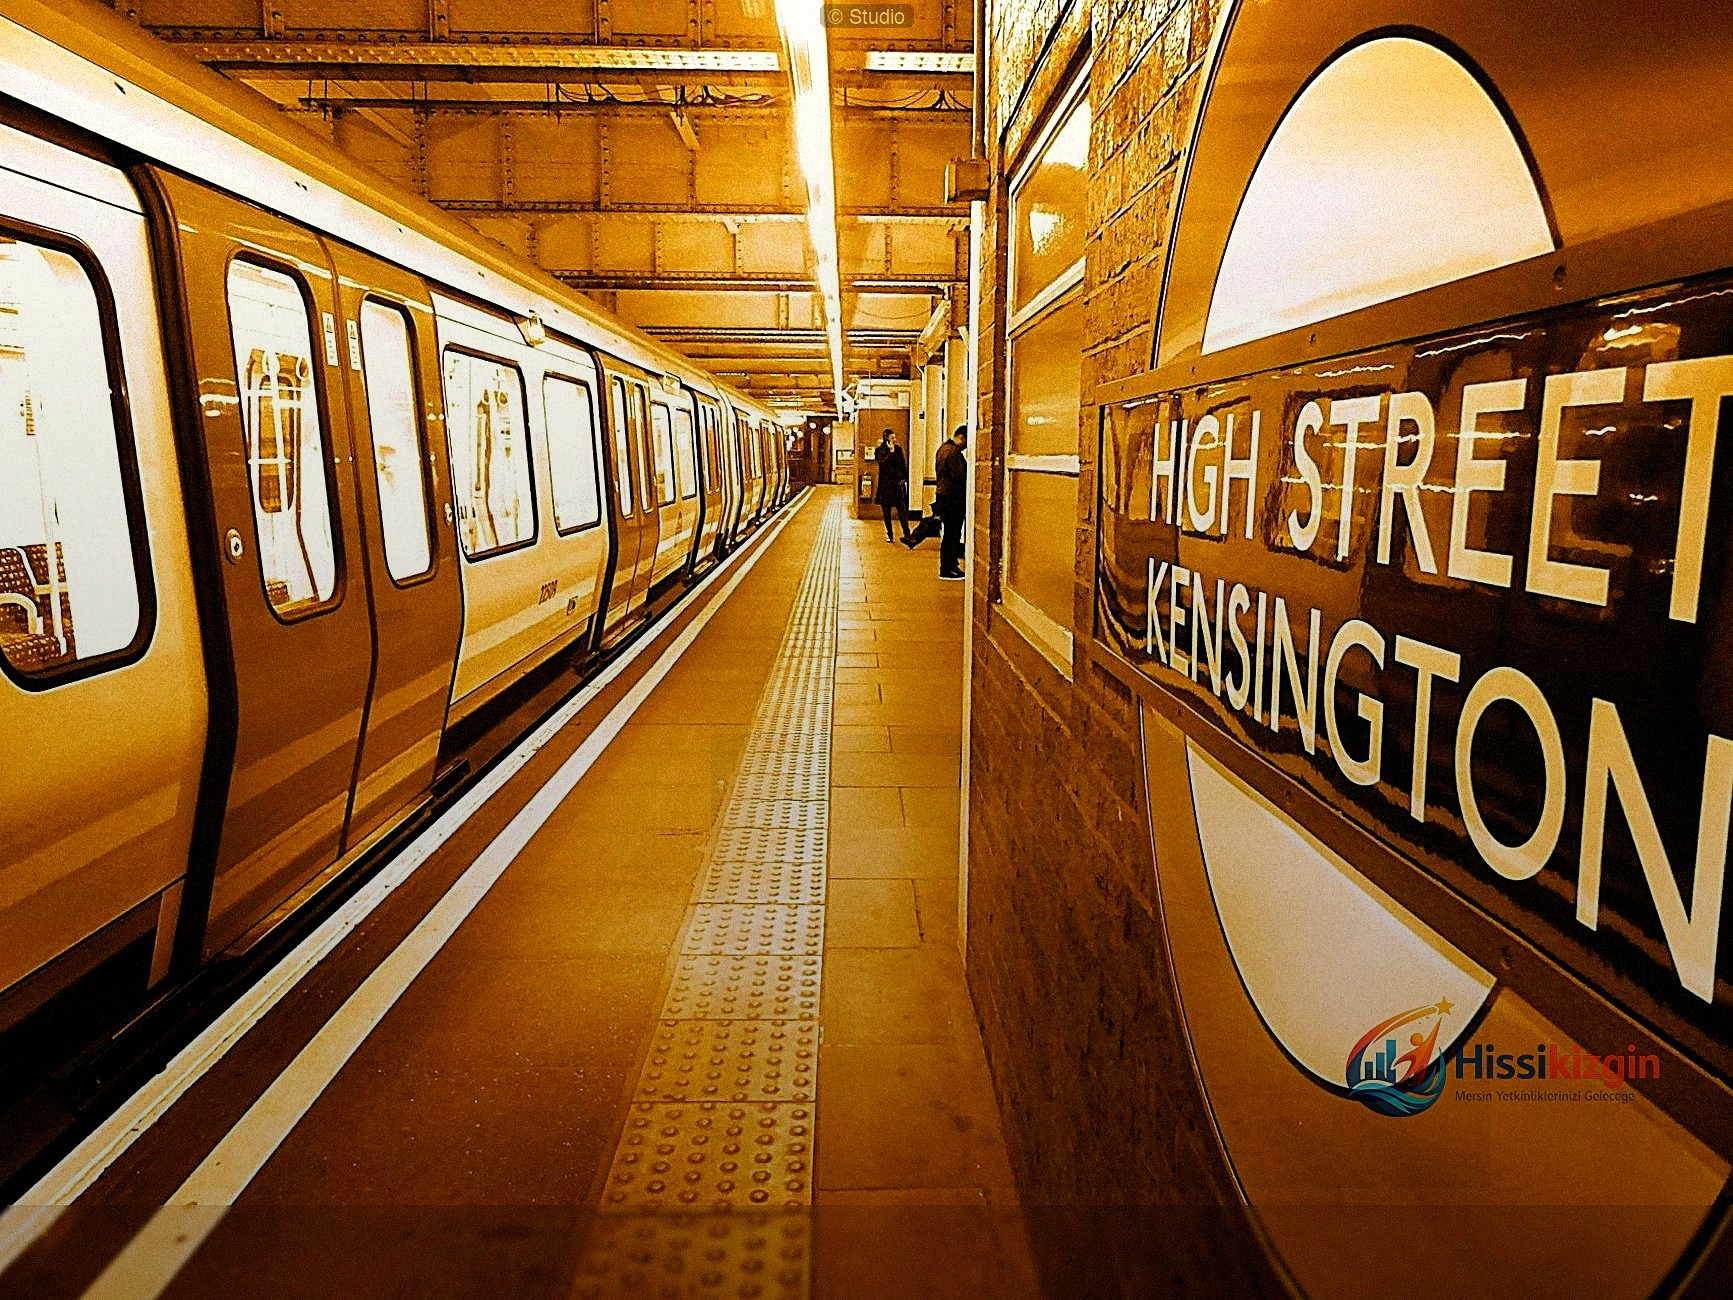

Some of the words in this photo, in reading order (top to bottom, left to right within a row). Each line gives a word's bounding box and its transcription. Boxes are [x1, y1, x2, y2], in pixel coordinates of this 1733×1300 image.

[1149, 409, 1261, 540] HIGH
[1290, 354, 1733, 625] STREET
[1146, 558, 1733, 1004] KENSINGTON
